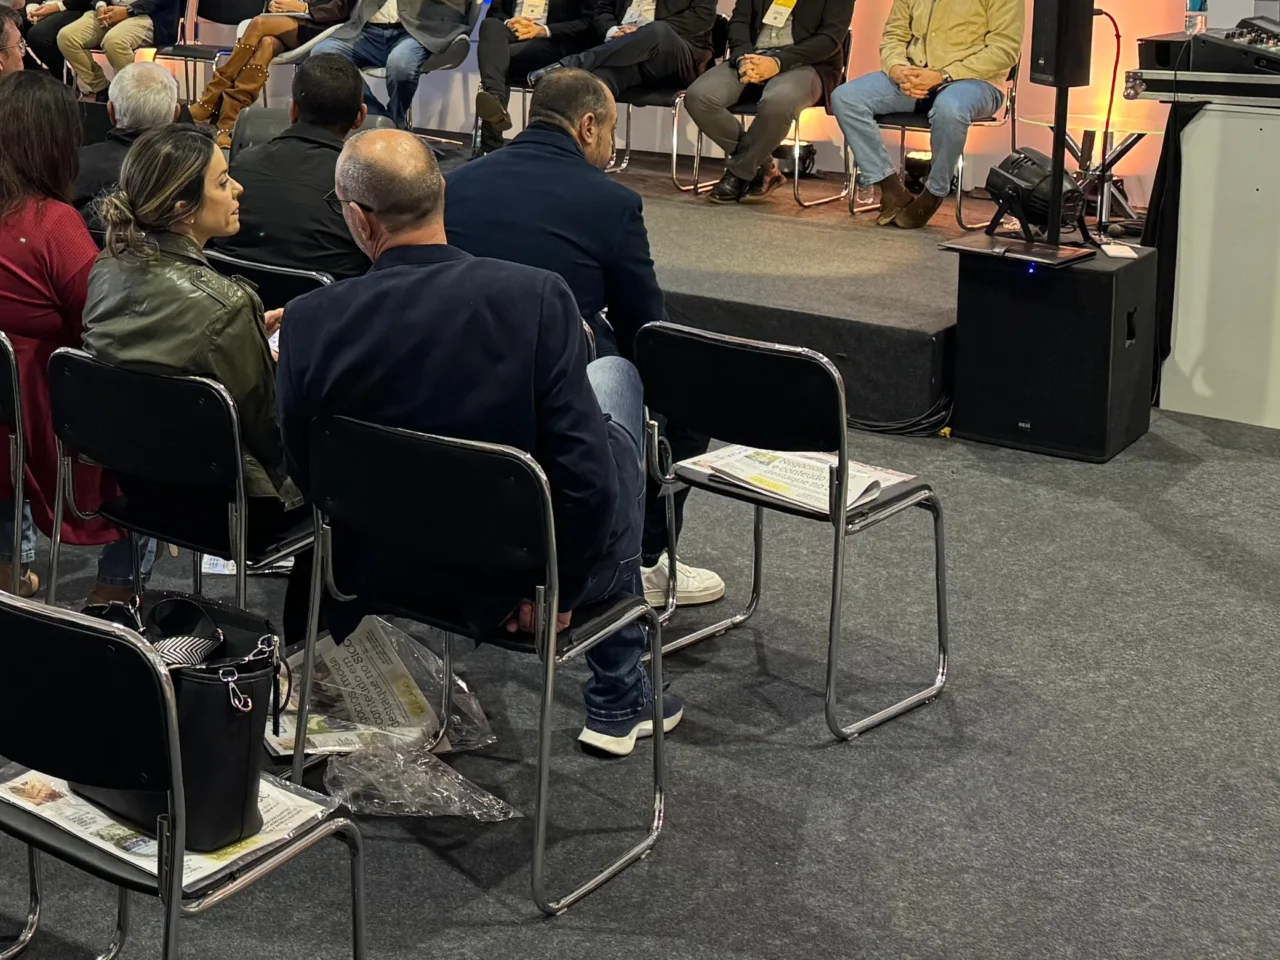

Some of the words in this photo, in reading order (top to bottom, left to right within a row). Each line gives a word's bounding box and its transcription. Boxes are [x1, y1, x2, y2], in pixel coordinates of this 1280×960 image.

[763, 469, 808, 486] destaque
[809, 482, 825, 490] no
[780, 466, 826, 481] conteúdo
[329, 657, 352, 689] moda
[342, 656, 358, 674] em
[361, 664, 375, 680] no
[371, 680, 401, 728] destaque
